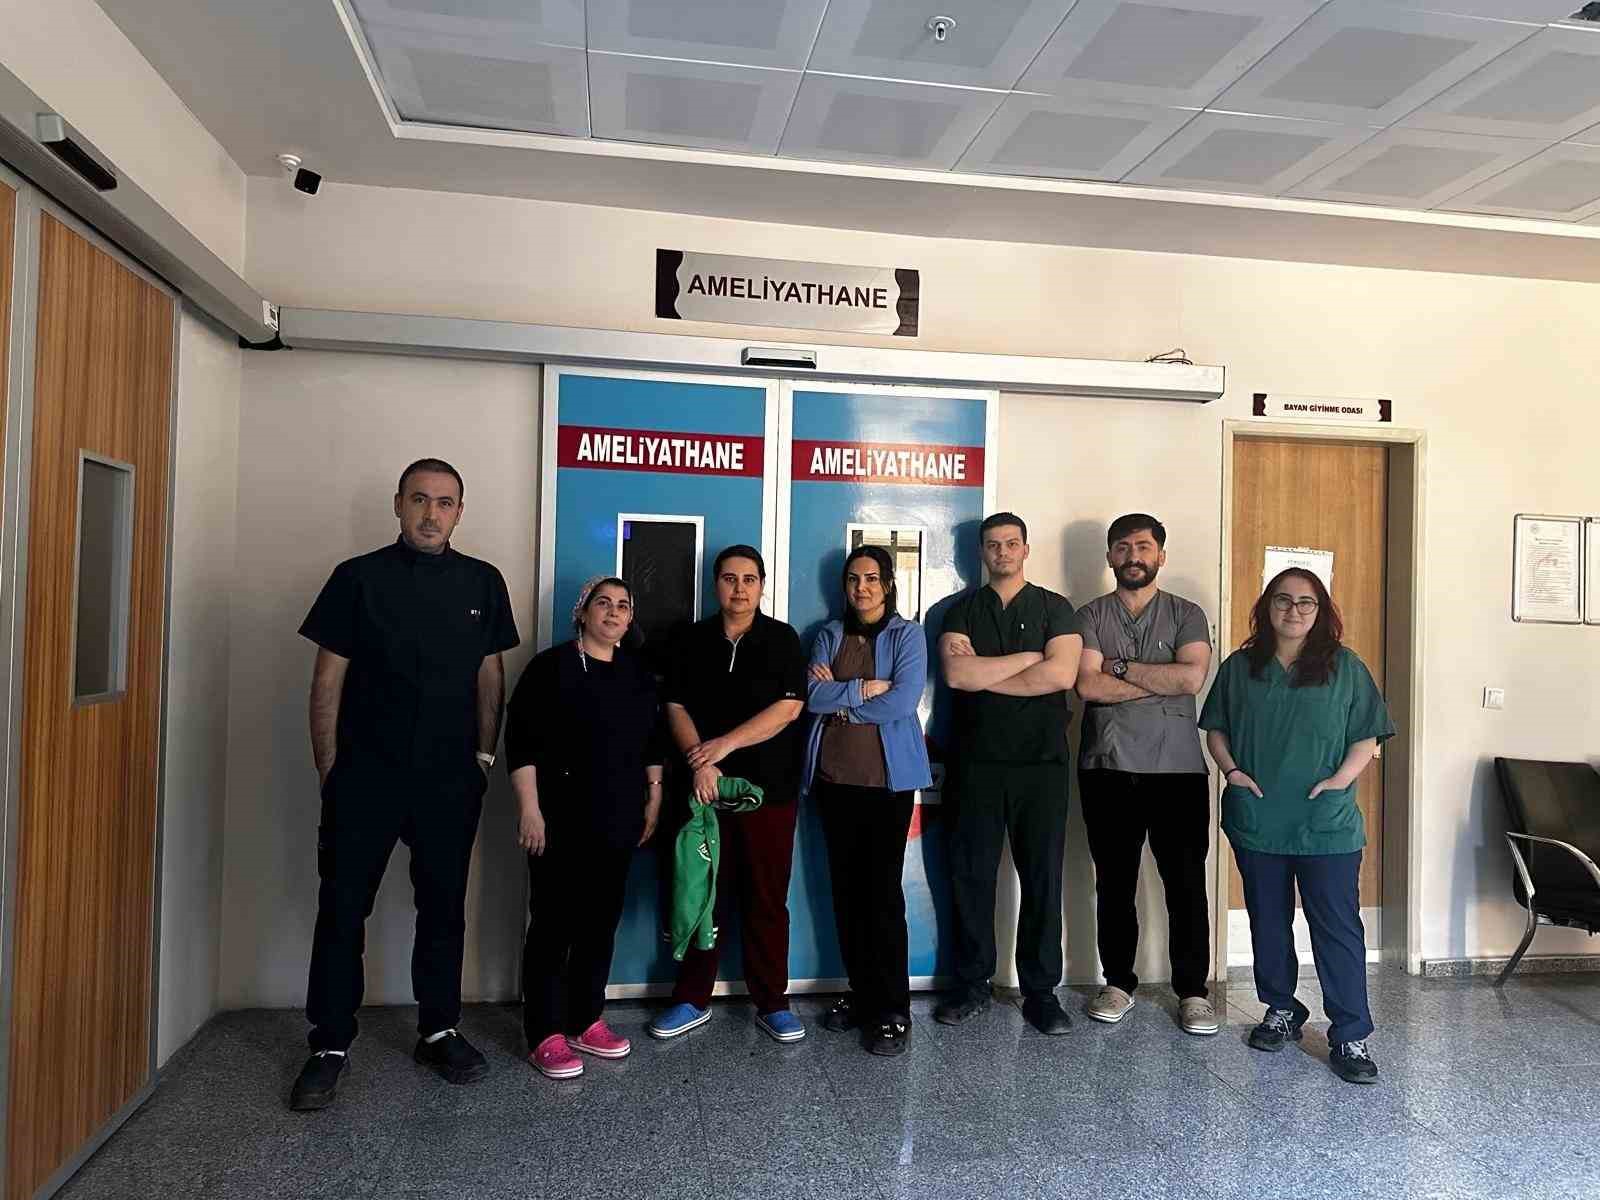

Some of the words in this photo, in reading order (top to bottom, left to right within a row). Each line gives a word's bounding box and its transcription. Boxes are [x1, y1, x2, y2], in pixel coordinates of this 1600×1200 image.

[687, 274, 888, 309] AMELİYATHANE
[1284, 403, 1308, 411] BAYAN
[1309, 403, 1340, 413] GİYİNME
[1341, 405, 1363, 414] ODASI
